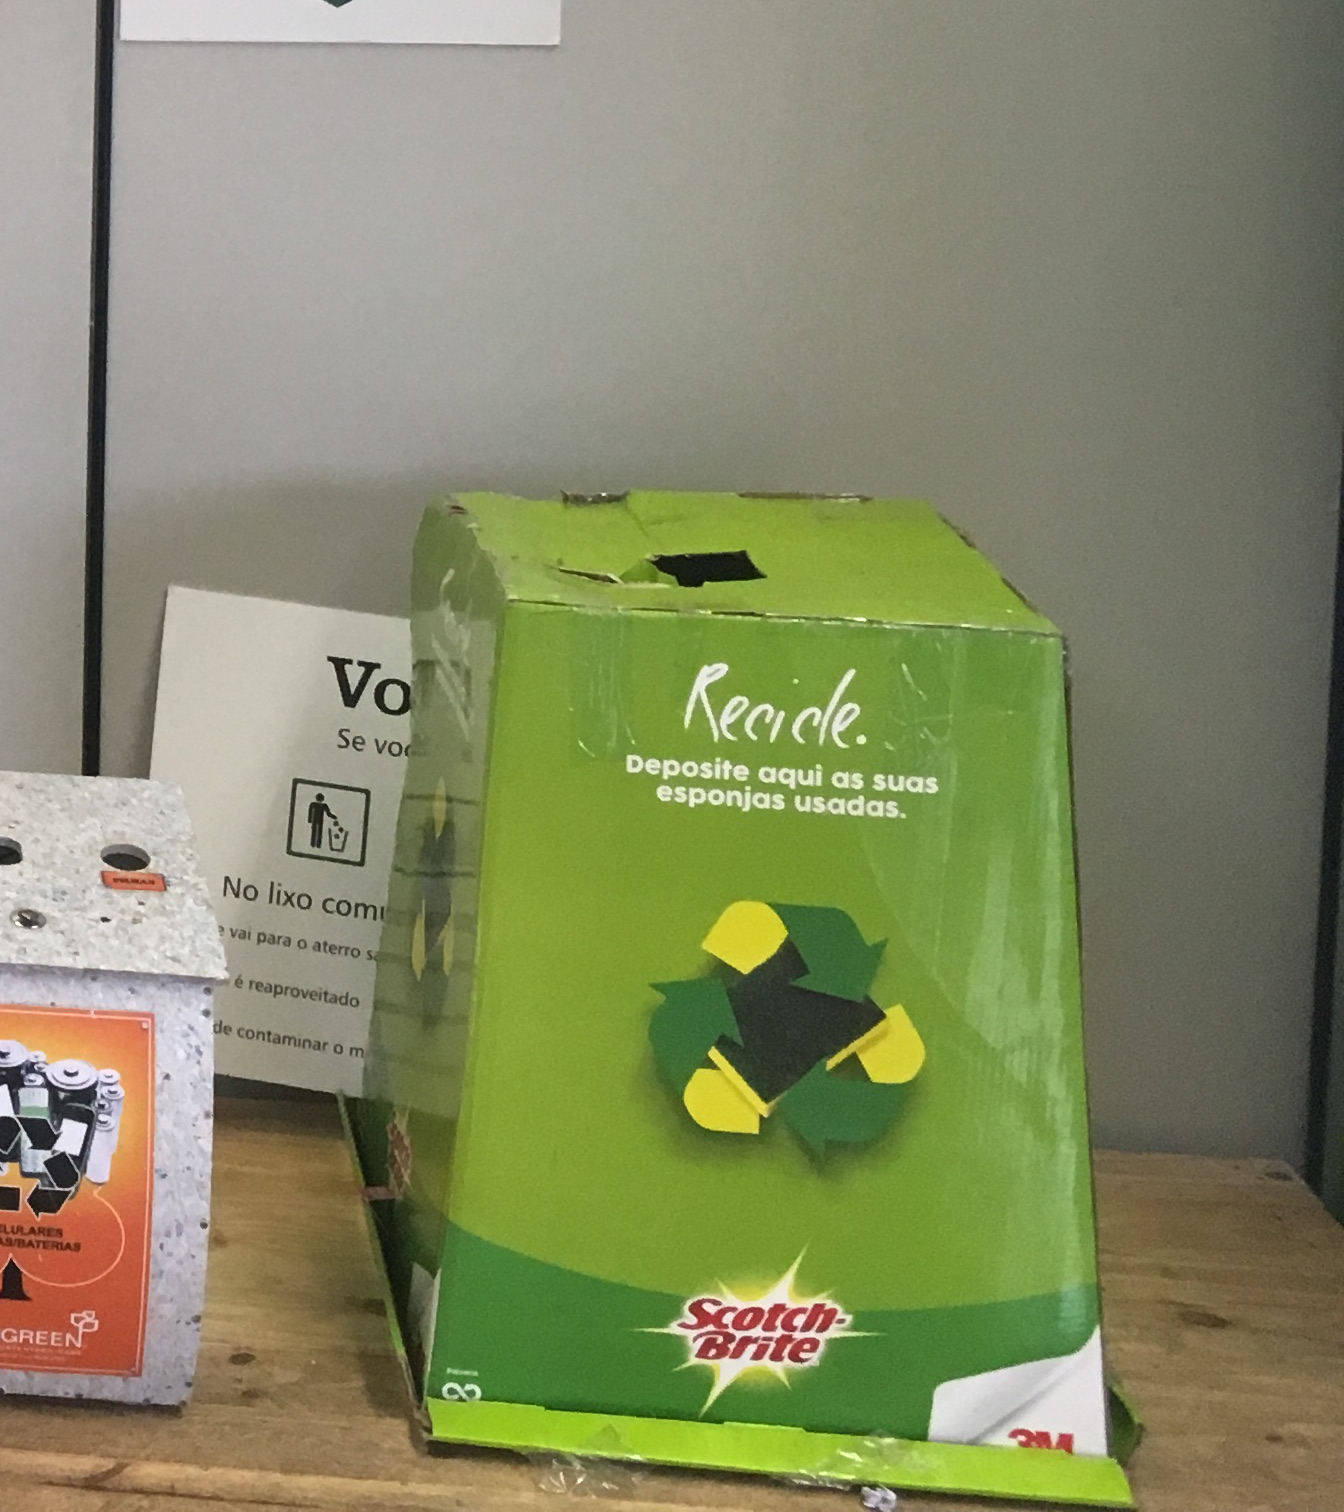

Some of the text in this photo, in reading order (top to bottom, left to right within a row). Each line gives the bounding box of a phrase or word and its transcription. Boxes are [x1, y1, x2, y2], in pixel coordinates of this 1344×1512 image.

[337, 728, 366, 752] Se
[627, 755, 938, 793] Deposite aqui as suas
[657, 785, 906, 818] esponjas usadas.
[222, 876, 258, 902] No
[268, 881, 312, 910] lixo
[230, 926, 252, 940] vai
[257, 931, 292, 947] para
[297, 939, 307, 949] o
[313, 941, 361, 959] aterro
[234, 974, 360, 1008] é reaproveitado
[213, 1020, 232, 1036] de
[237, 1026, 329, 1051] contaminar
[334, 1044, 343, 1054] o
[693, 1330, 820, 1363] Brite
